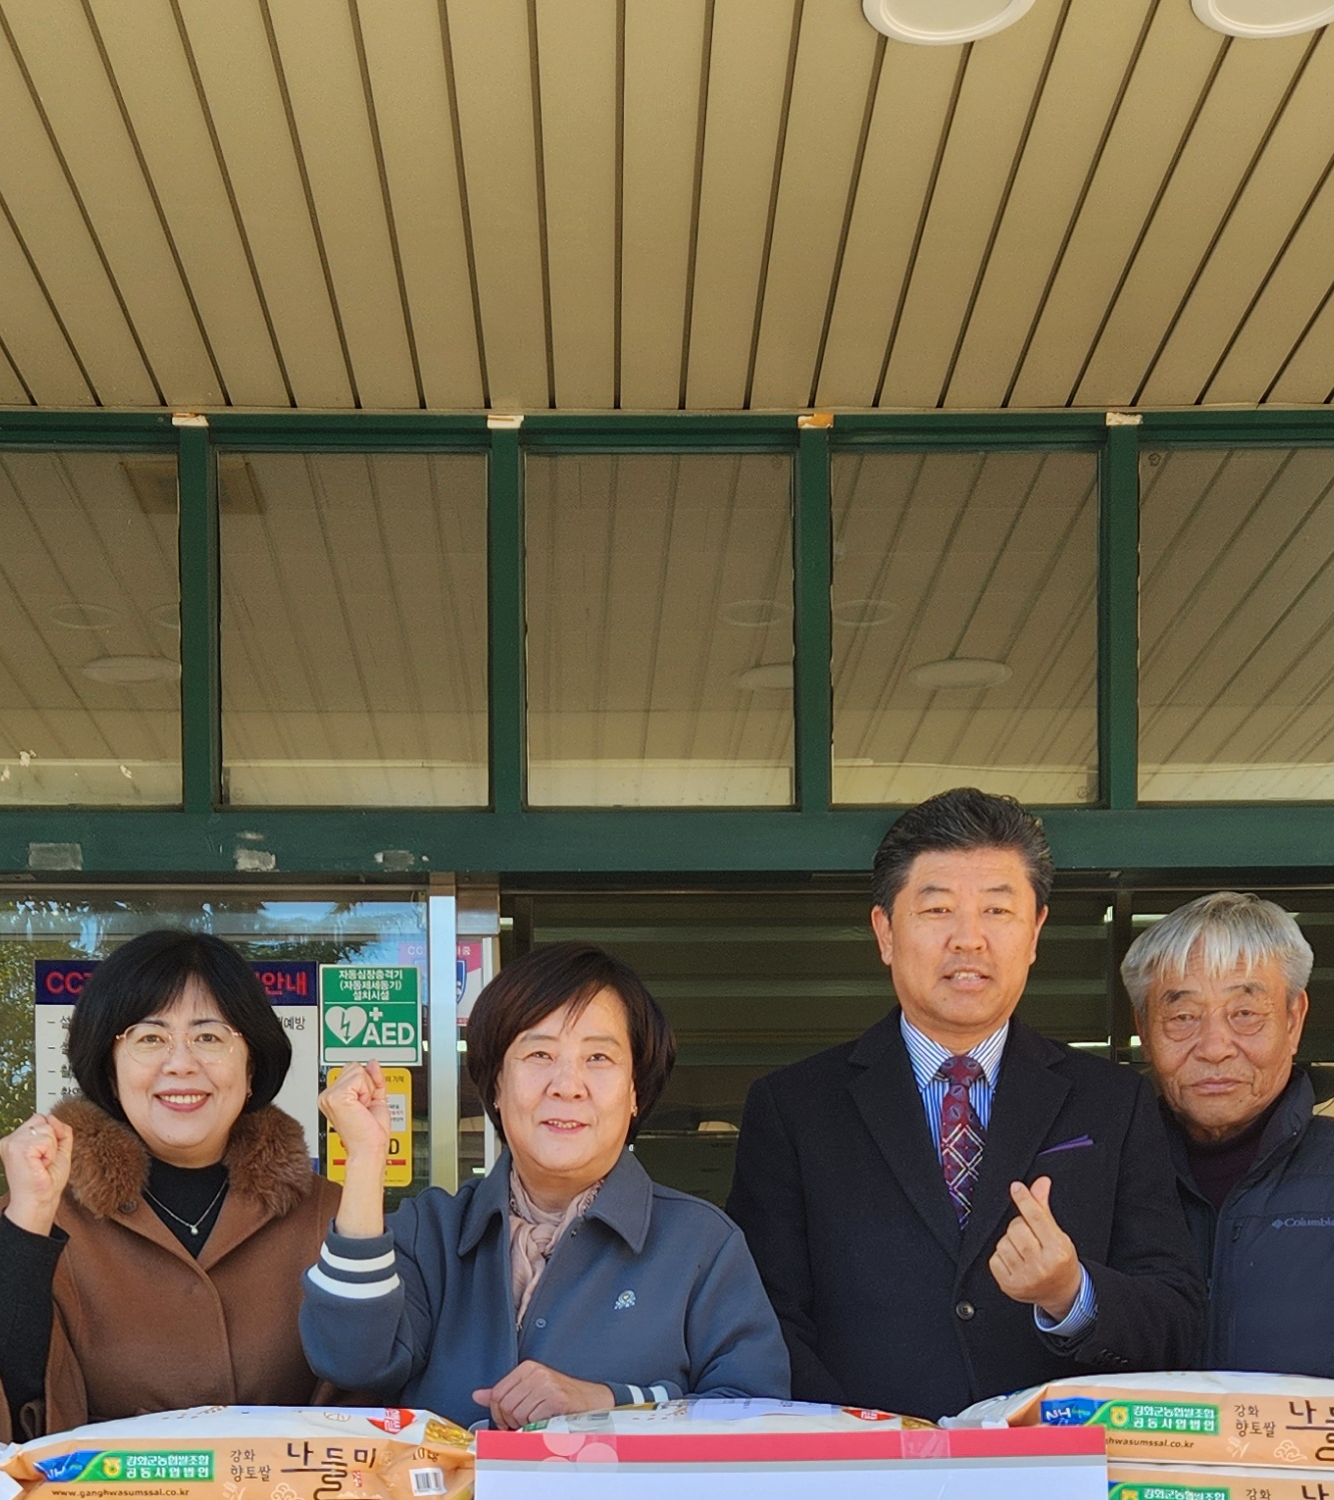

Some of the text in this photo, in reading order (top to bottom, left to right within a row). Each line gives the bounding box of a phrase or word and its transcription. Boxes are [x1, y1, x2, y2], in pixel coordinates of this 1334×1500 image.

[339, 969, 403, 980] 자동심장충격기
[255, 971, 307, 996] 안내
[339, 980, 402, 991] (자동제세동기)
[352, 990, 390, 1001] 설치시설
[362, 1022, 415, 1045] AED
